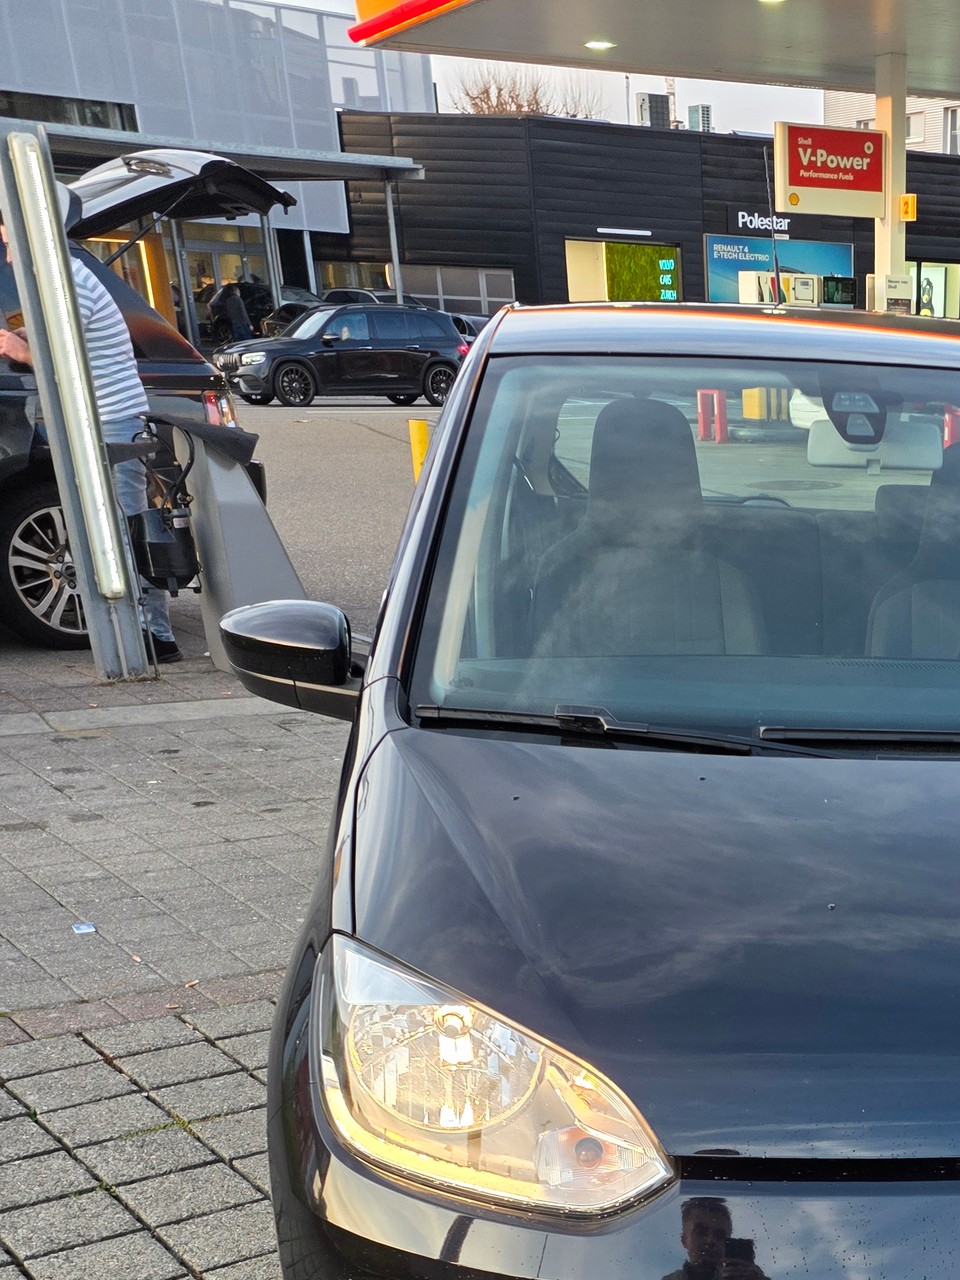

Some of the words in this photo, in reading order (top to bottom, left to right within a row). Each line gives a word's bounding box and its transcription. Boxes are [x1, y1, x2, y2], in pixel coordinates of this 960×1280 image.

[797, 137, 812, 146] Shell
[798, 147, 871, 170] V-Power
[799, 169, 838, 181] Performance
[838, 172, 854, 181] Fuels
[903, 201, 910, 215] 2
[738, 211, 791, 231] Polestar
[713, 244, 744, 253] RENAULT
[713, 252, 738, 260] E-TECH
[738, 253, 770, 262] ELECTRIC
